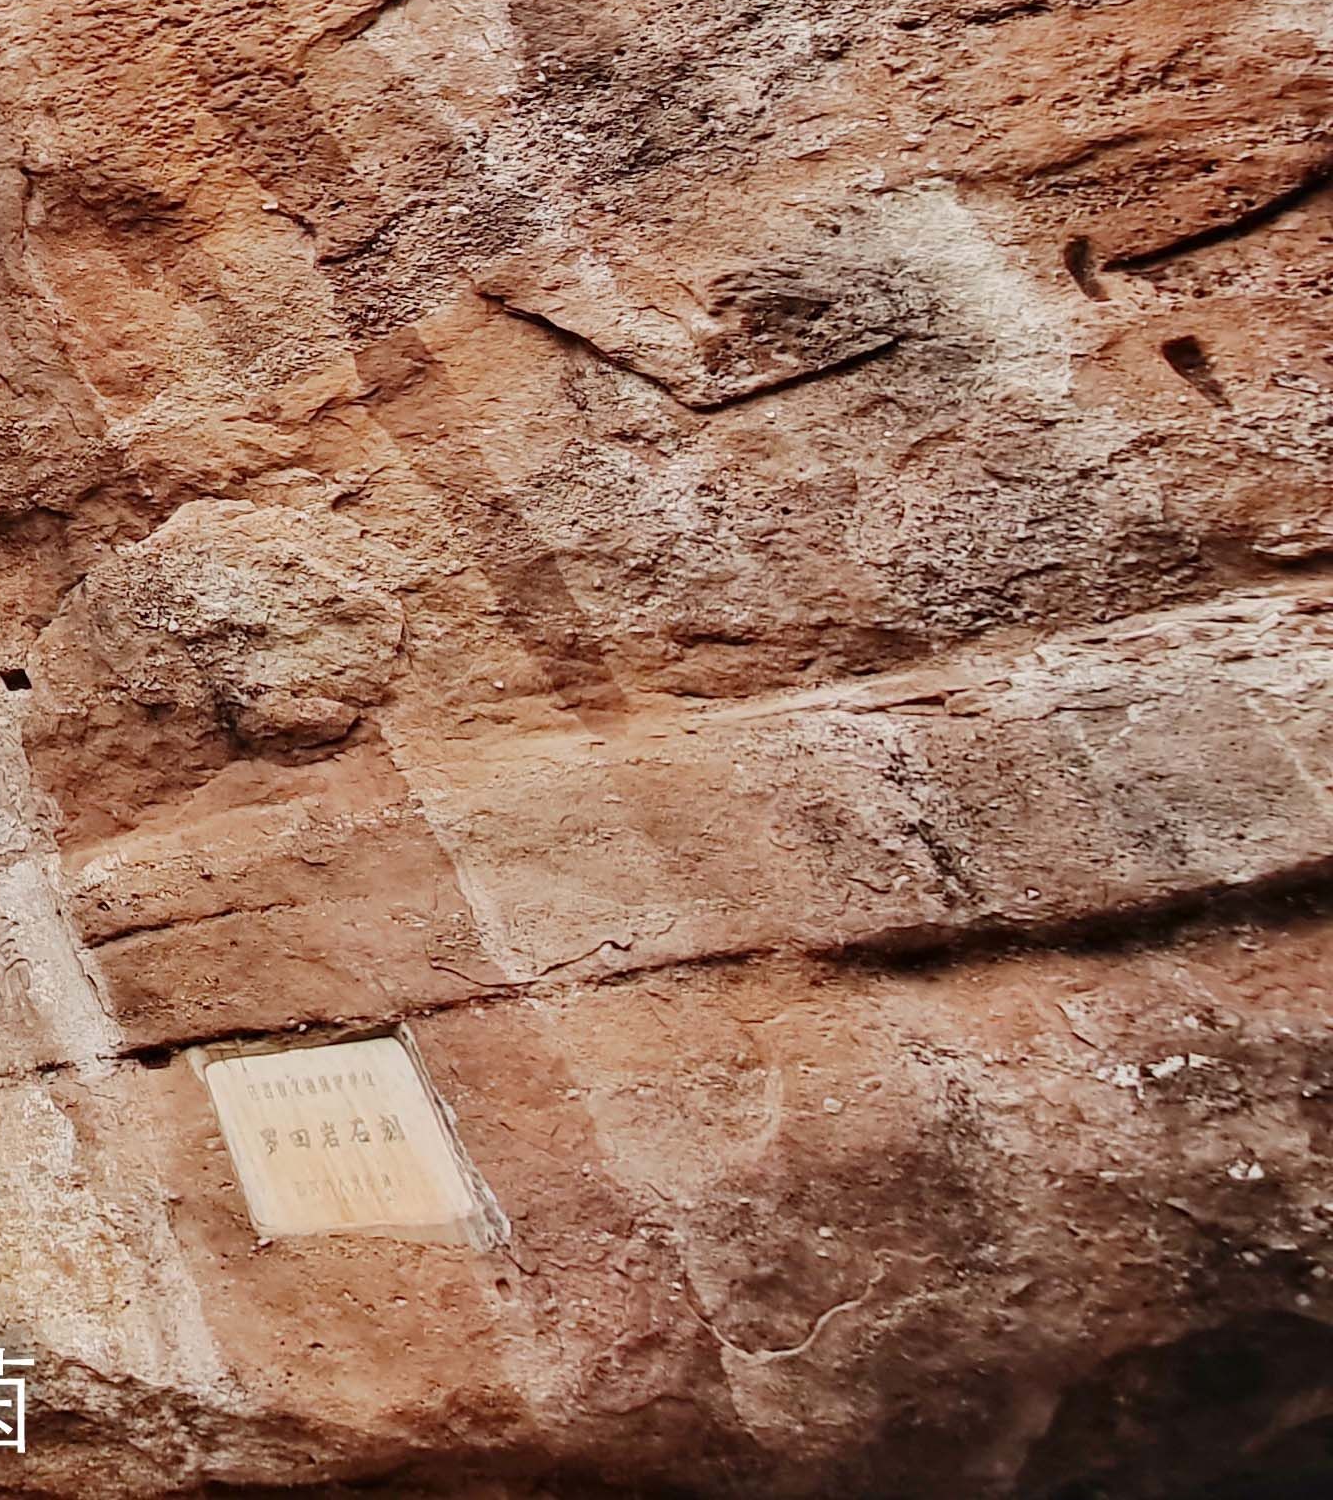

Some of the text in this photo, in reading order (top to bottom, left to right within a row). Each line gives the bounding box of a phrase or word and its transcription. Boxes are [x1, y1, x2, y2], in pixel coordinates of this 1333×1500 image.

[259, 1114, 407, 1156] 罗田岩石刻
